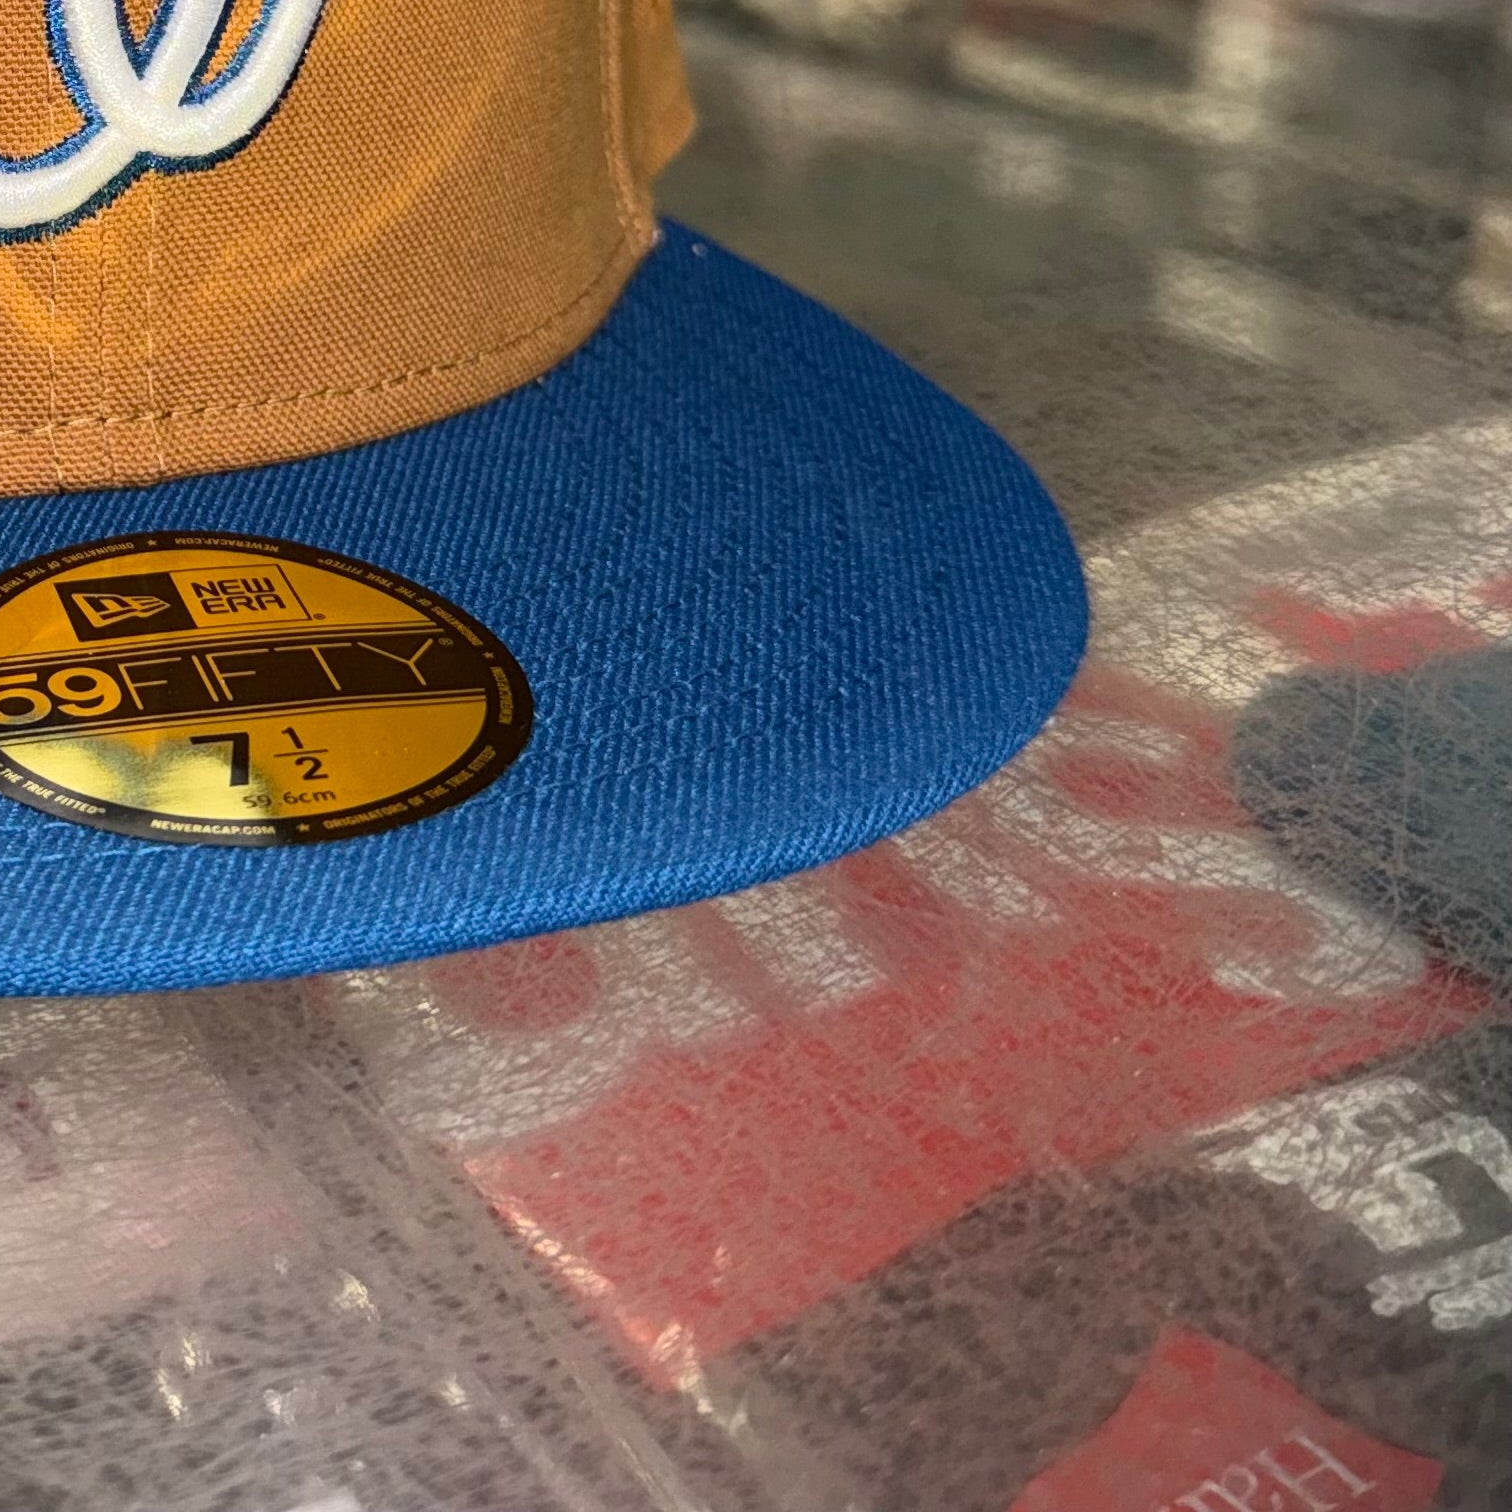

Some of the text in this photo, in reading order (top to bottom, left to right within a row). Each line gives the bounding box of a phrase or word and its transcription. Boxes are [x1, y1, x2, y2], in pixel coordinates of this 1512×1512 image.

[63, 541, 135, 565] ORIGINATORS
[174, 537, 280, 553] NEWERACAP.COM
[190, 576, 276, 599] NEW
[199, 592, 287, 615] ERA
[189, 731, 251, 788] 7
[0, 767, 24, 785] THE
[21, 779, 56, 800] TRUE
[322, 801, 409, 831] ORIGINATORS
[407, 795, 425, 808] OF
[423, 784, 450, 800] THE
[150, 818, 277, 836] NEWERACAP.COM
